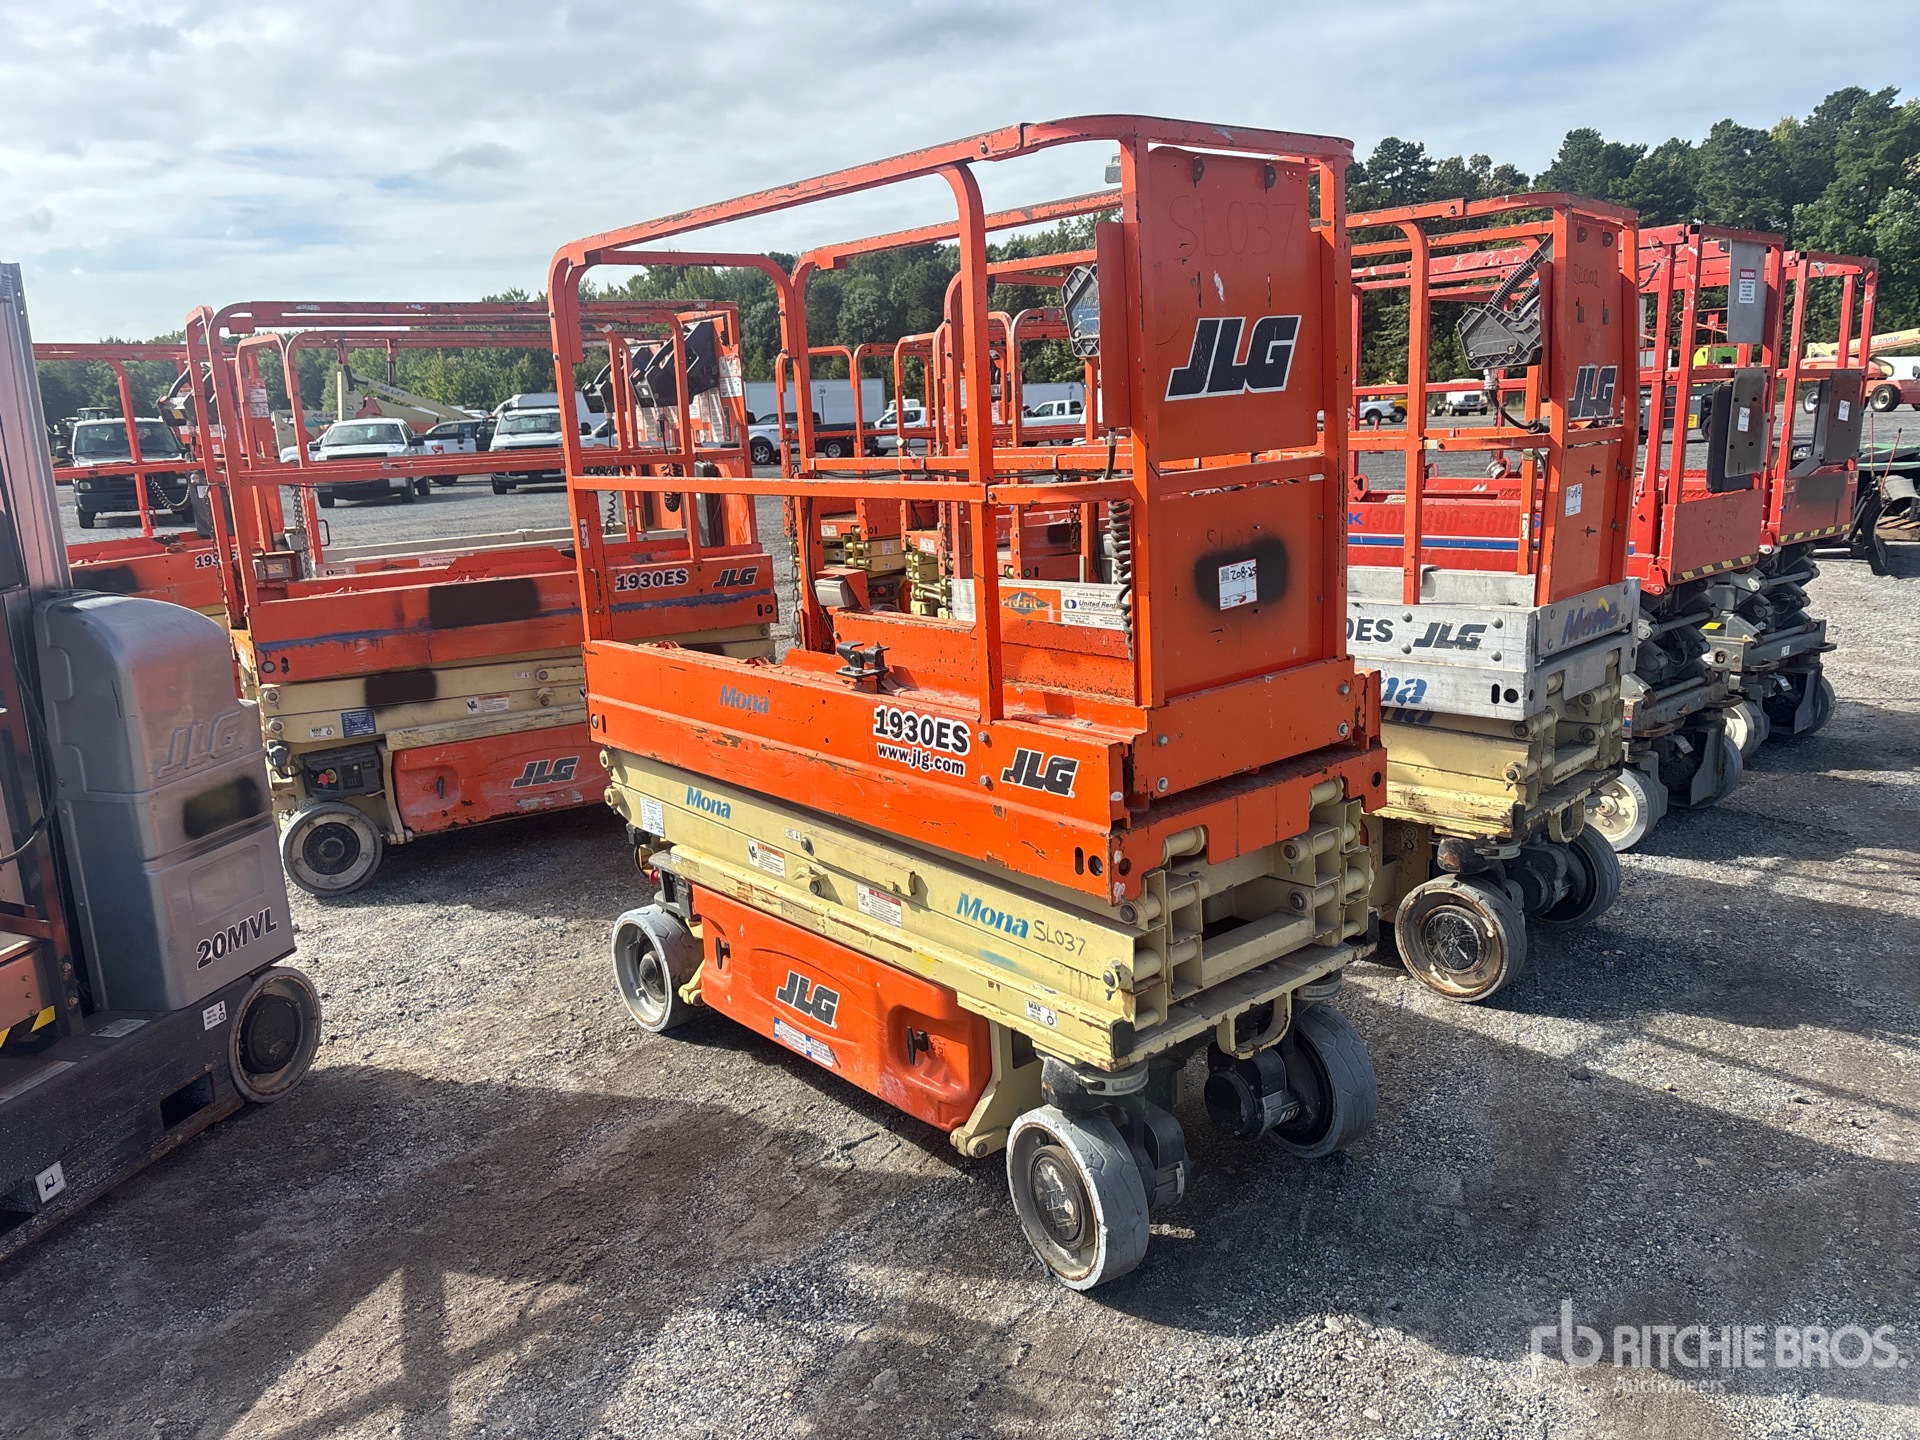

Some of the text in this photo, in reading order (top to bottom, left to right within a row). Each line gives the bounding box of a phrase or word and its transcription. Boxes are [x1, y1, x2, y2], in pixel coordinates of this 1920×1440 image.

[1170, 196, 1296, 260] SL037
[1165, 315, 1302, 401] JLG
[1568, 365, 1618, 420] JLG
[615, 569, 688, 591] 1930ES
[713, 567, 758, 588] JLG
[1078, 599, 1100, 607] United
[1412, 621, 1489, 651] JLG
[719, 685, 769, 714] Mona
[1381, 676, 1428, 706] na
[155, 711, 242, 779] JLG
[874, 707, 969, 754] 1930ES
[511, 756, 580, 789] JLG
[877, 744, 965, 776] www.jlg.com
[1001, 747, 1079, 796] JLG
[686, 785, 732, 819] Mona
[956, 892, 1029, 939] Mona
[196, 907, 278, 970] 20MVL
[1034, 920, 1086, 956] SL037
[776, 970, 840, 1028] JLG
[1028, 1001, 1042, 1012] MAX
